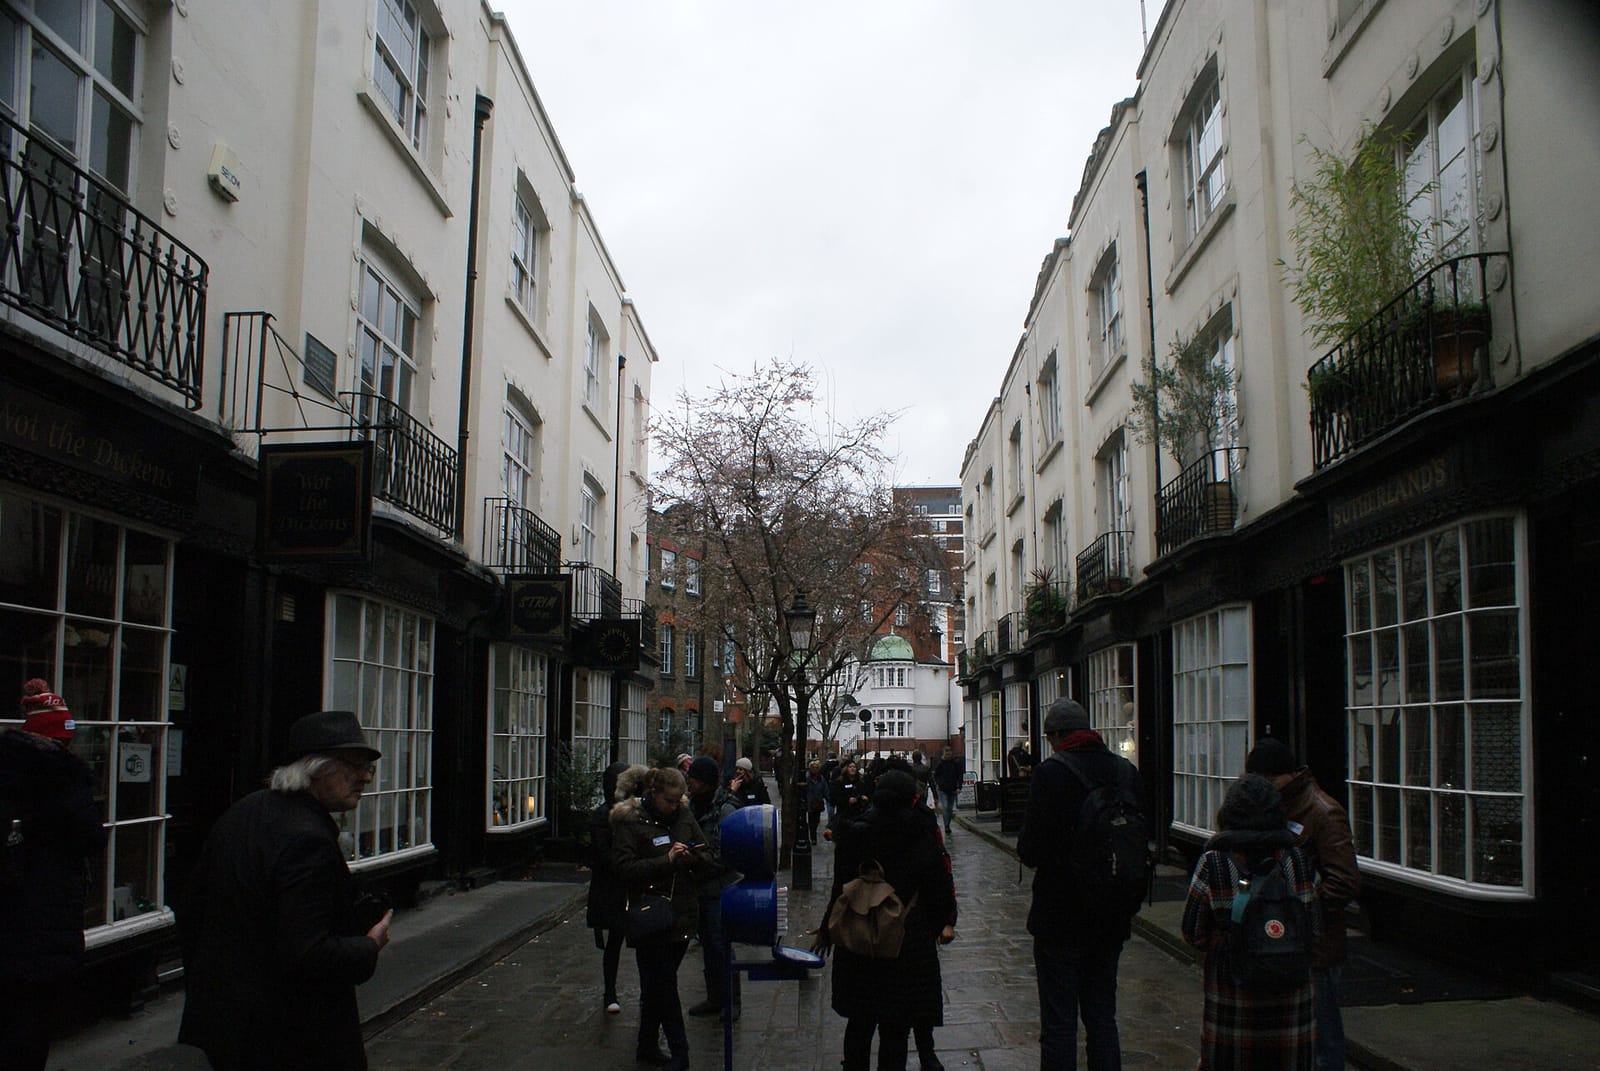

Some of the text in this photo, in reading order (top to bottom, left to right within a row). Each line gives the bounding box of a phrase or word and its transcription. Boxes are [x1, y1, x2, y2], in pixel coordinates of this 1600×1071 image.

[49, 420, 86, 457] the
[94, 439, 174, 490] Dickens
[1333, 458, 1446, 528] SUTHERLANDS
